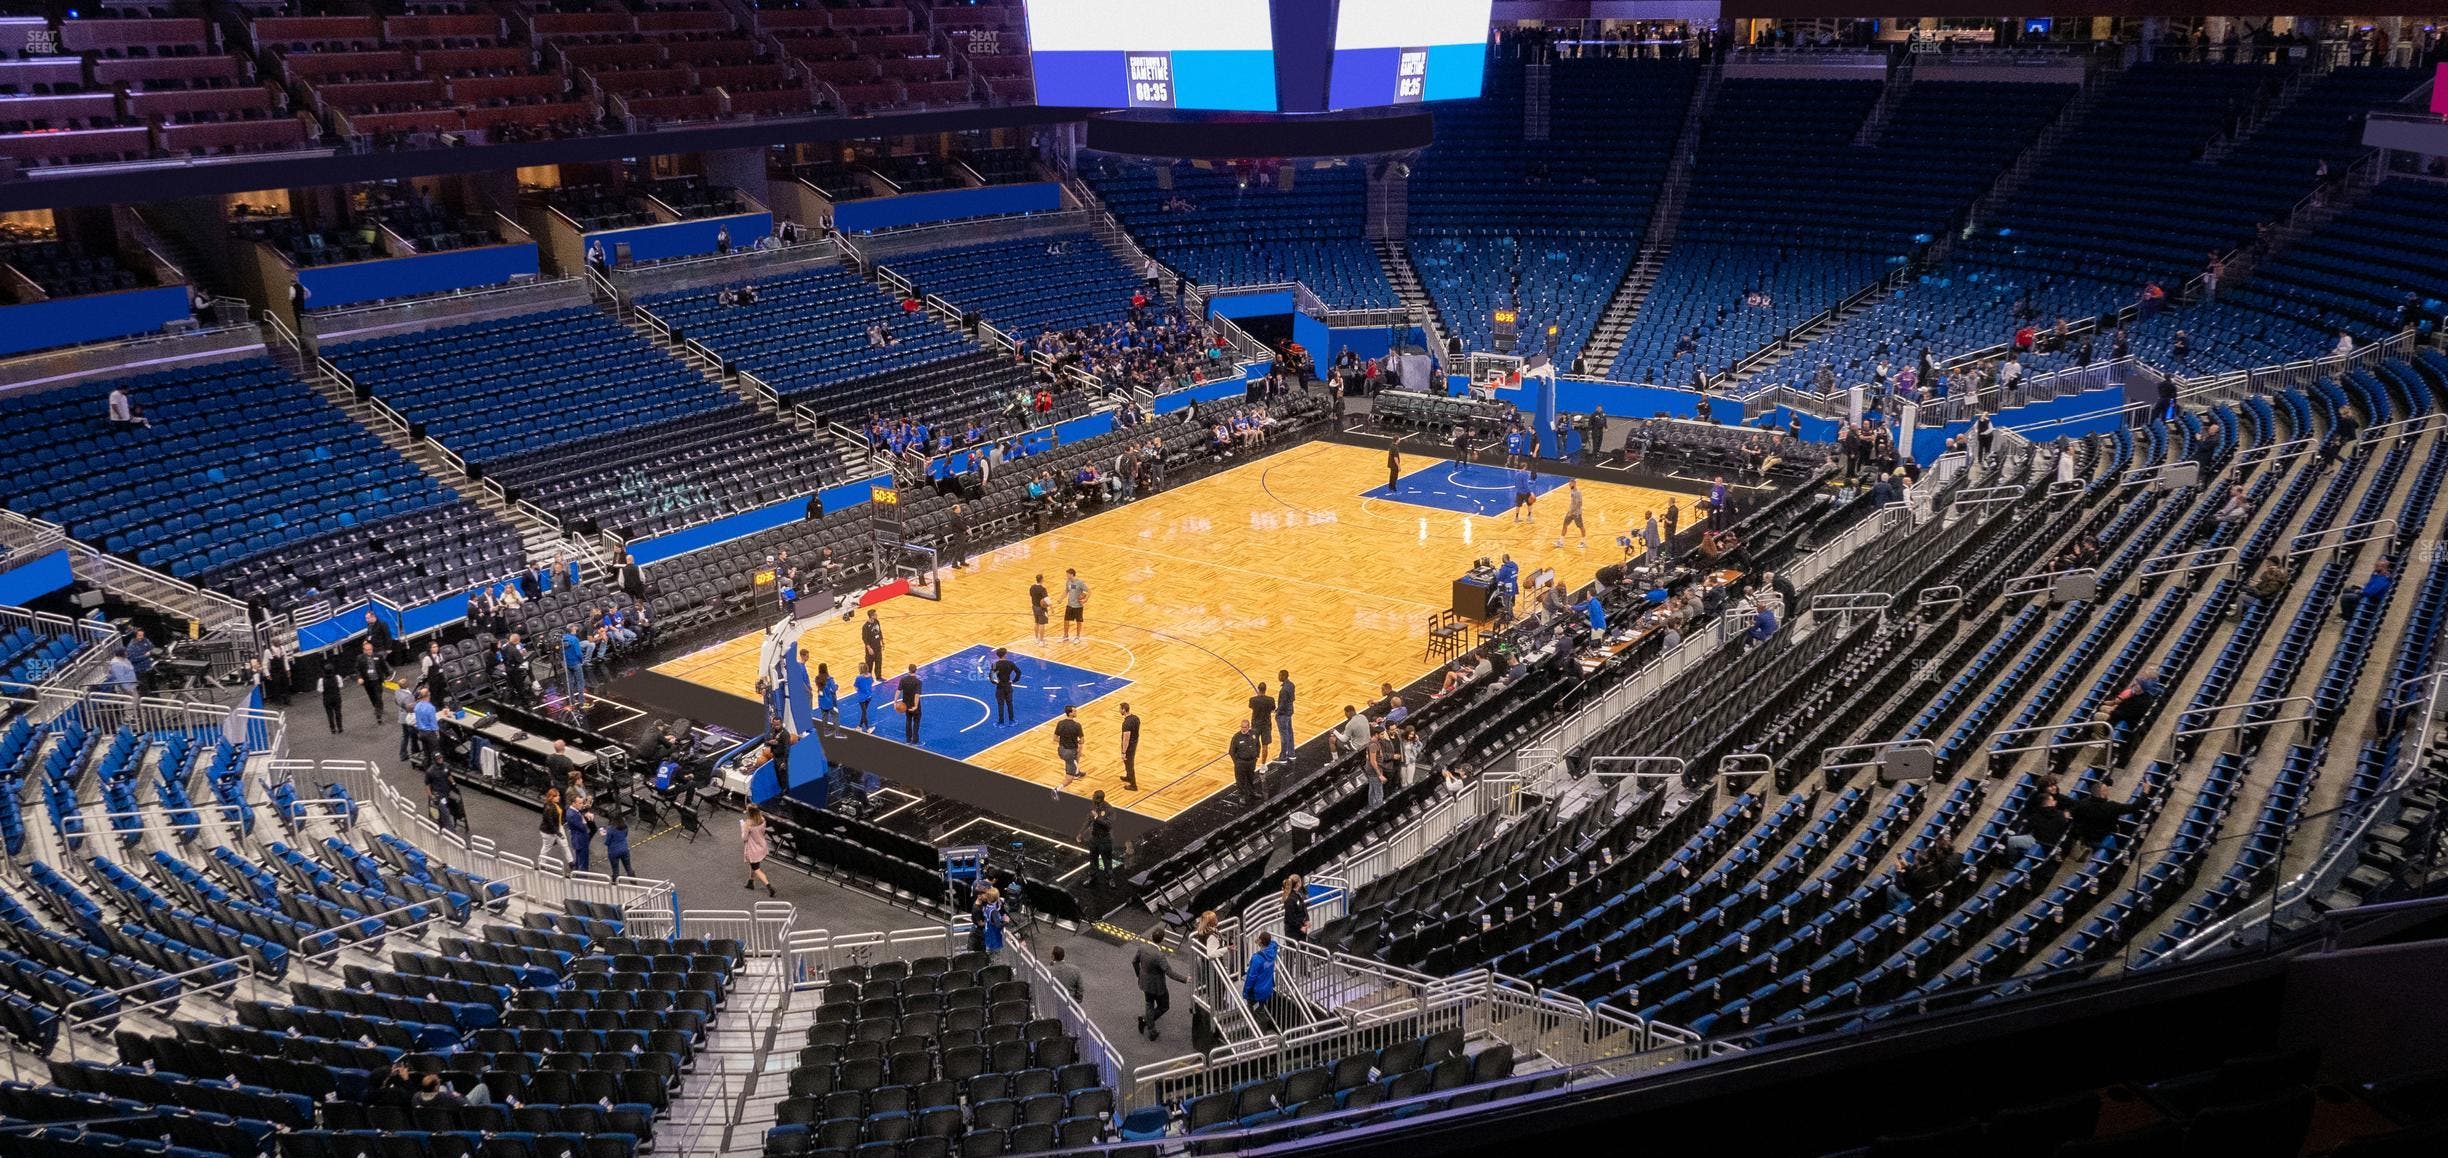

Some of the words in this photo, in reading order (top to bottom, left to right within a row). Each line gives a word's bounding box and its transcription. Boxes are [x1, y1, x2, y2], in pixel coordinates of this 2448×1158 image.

[1131, 66, 1169, 80] GAMETIME
[1495, 312, 1515, 323] 60:35
[874, 489, 897, 504] 60:35
[756, 571, 775, 585] 60:35
